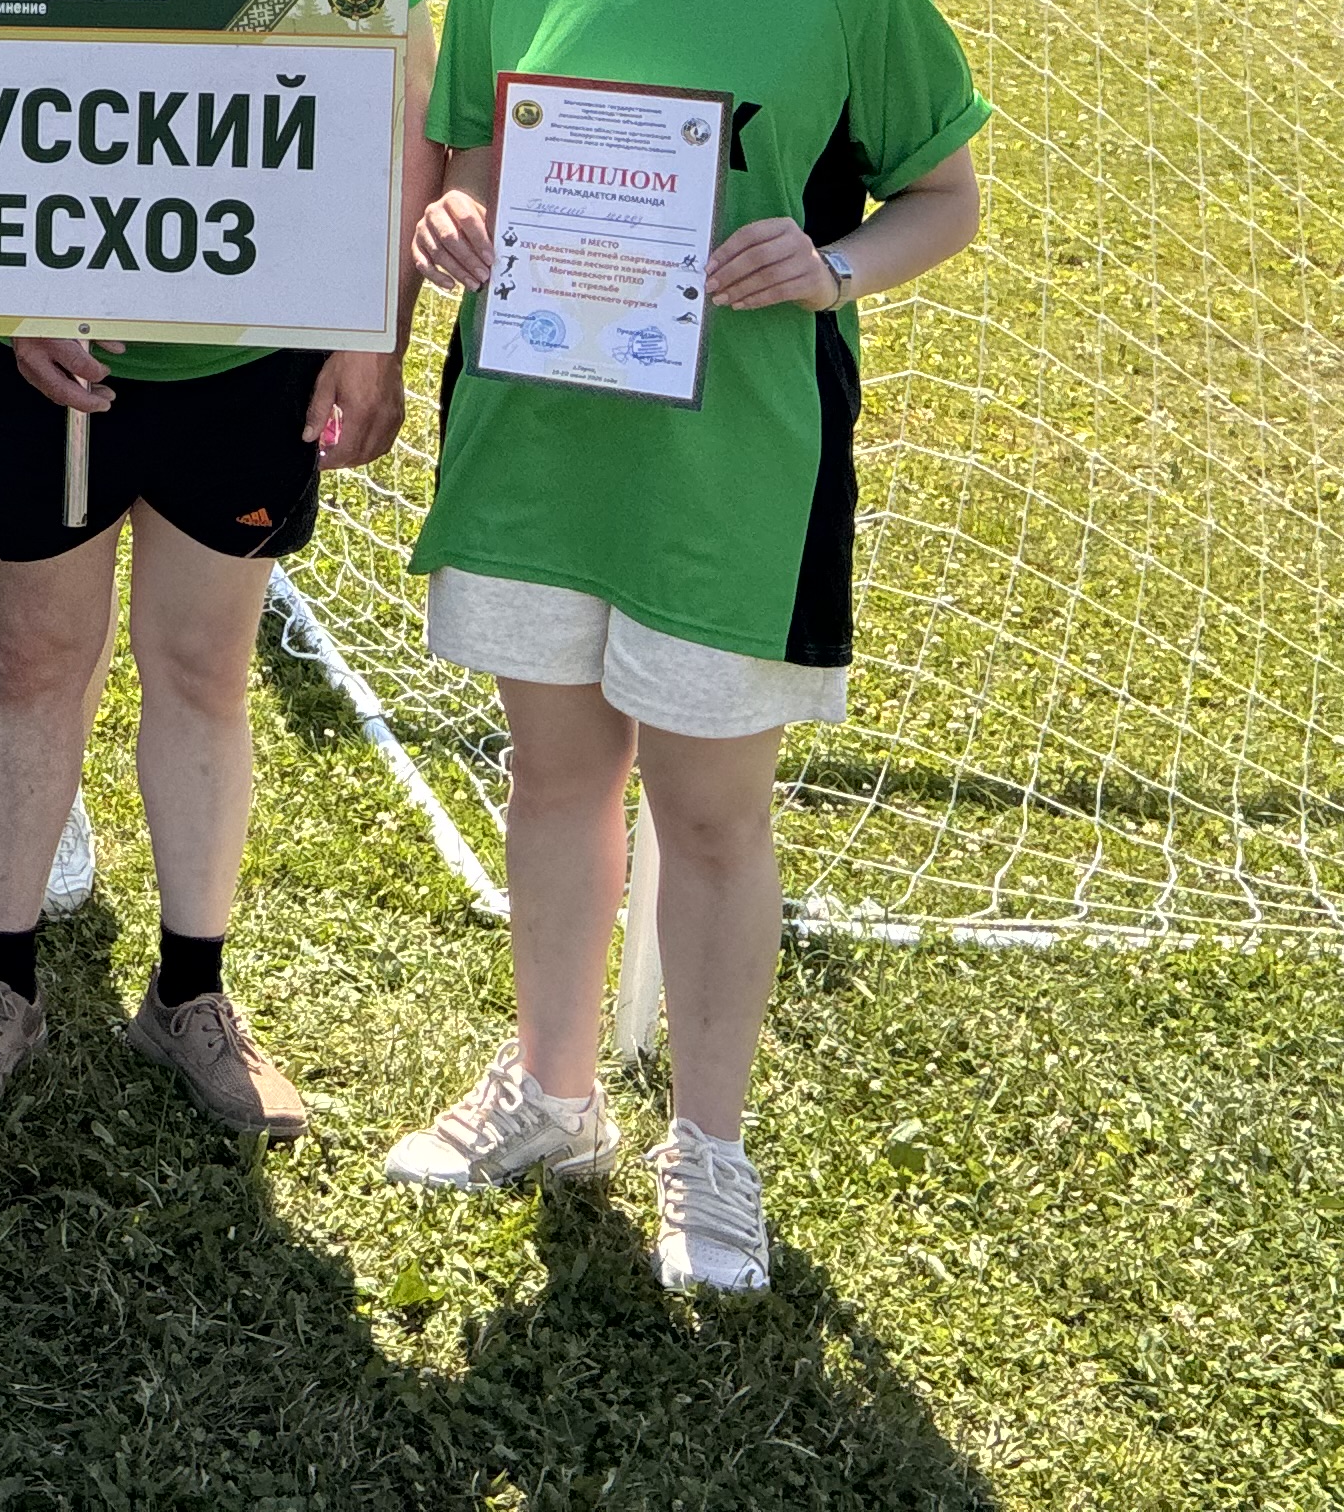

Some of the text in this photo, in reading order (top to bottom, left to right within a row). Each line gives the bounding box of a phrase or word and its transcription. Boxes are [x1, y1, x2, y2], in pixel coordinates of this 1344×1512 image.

[544, 160, 679, 193] ДИПЛОМ
[545, 186, 665, 207] НАГРАЖДАЕТСЯ КОМАНДА
[538, 244, 585, 256] областной
[588, 238, 619, 249] МЕСТО
